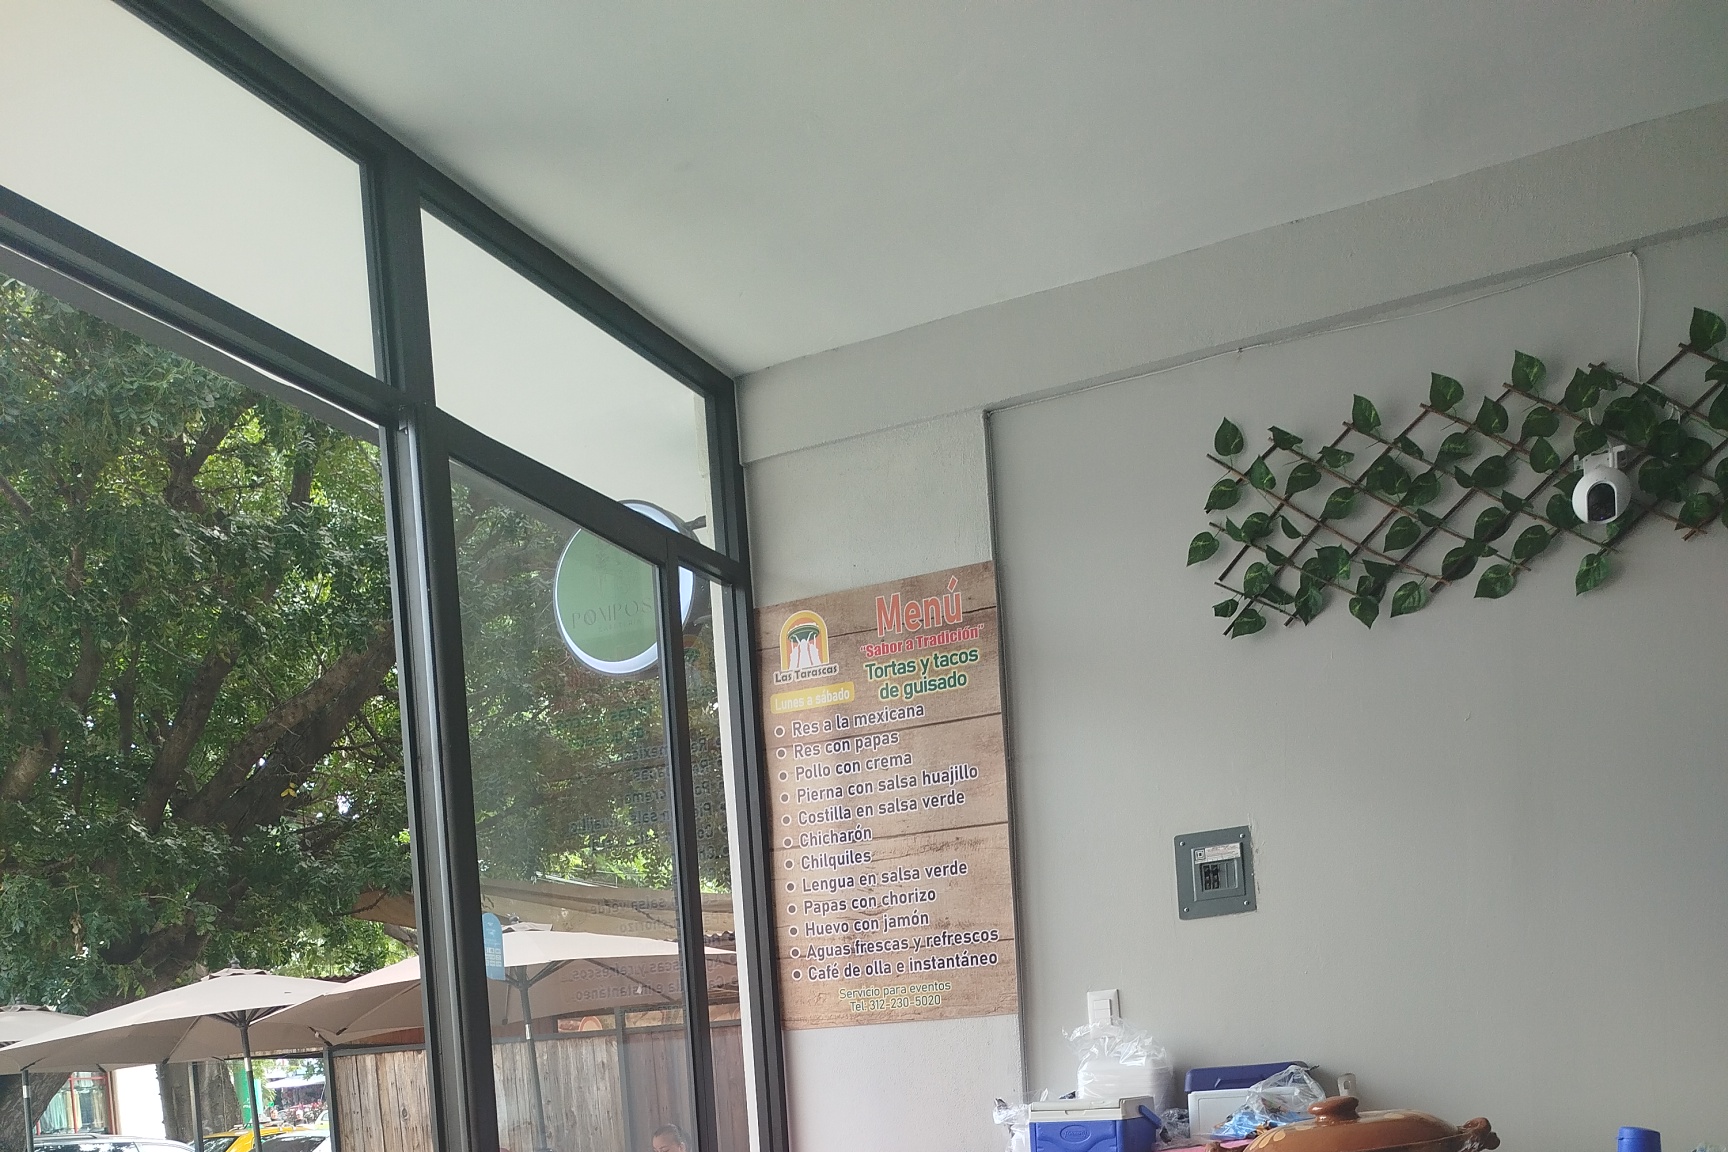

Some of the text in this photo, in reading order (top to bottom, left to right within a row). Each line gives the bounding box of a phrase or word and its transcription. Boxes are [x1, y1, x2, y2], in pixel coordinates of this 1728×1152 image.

[876, 576, 962, 636] Menú
[905, 640, 914, 651] a
[774, 665, 837, 684] Las Tarascas
[865, 649, 979, 681] Tortas y tacos
[775, 689, 850, 711] Lunes a sábado
[880, 671, 967, 700] de guisado
[792, 703, 925, 737] Res a la mexicana
[793, 731, 899, 759] Res con papas
[795, 752, 912, 781] Pollo con crema
[797, 763, 978, 803] Pierna con salsa huajillo
[798, 790, 965, 825] Costilla en salsa verde
[800, 825, 872, 848] Chicharón
[801, 850, 872, 871] Chilquiles
[802, 860, 968, 895] Lengua en salsa verde
[804, 887, 936, 917] Papas con chorizo
[805, 910, 929, 938] Huevo con jamón
[807, 928, 999, 961] Aguas frescas y refrescos
[808, 951, 998, 982] Café de olla e instantáneo
[839, 981, 951, 1000] Servicio para eventos
[850, 994, 941, 1012] Tel: 312-230-5020
